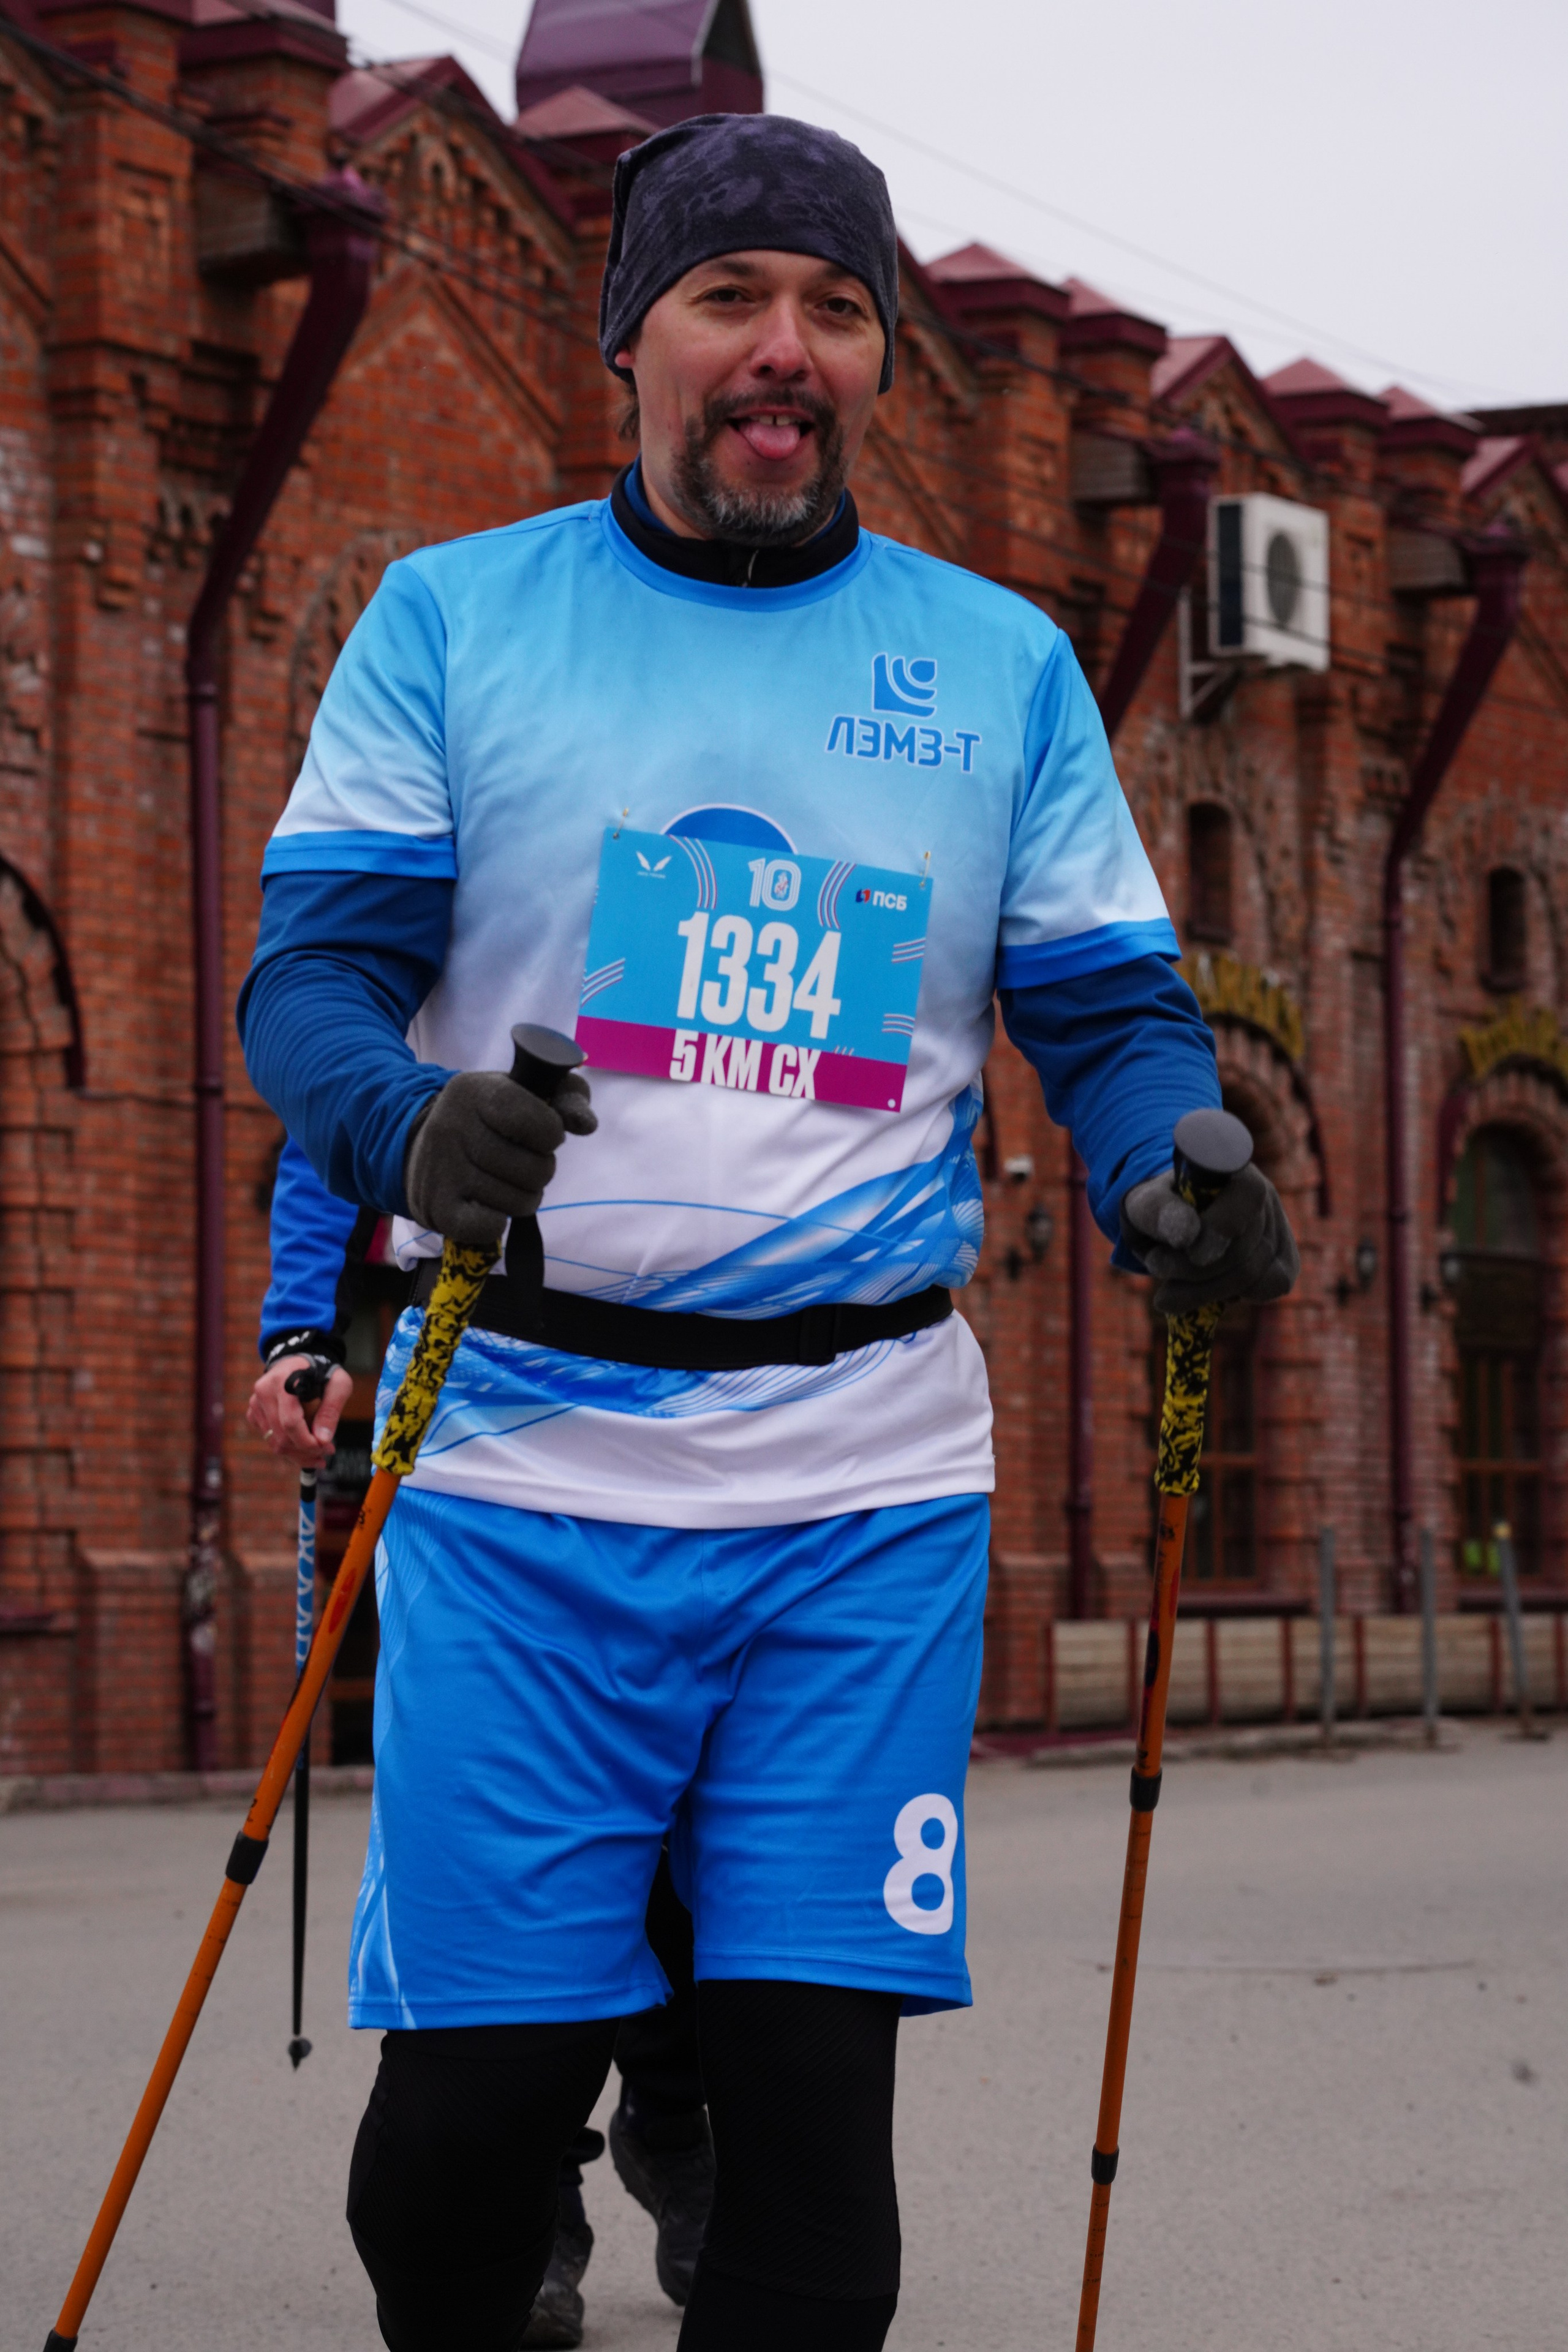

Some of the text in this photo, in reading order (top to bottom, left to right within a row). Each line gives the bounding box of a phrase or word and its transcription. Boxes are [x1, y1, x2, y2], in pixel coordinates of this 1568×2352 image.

[827, 715, 981, 772] ЛЭМЗ-Т
[748, 858, 801, 911] 10
[872, 891, 907, 911] ПСБ
[677, 911, 841, 1039] 1334
[669, 1028, 821, 1100] 5 КМ СХ
[883, 1793, 958, 1935] 8
